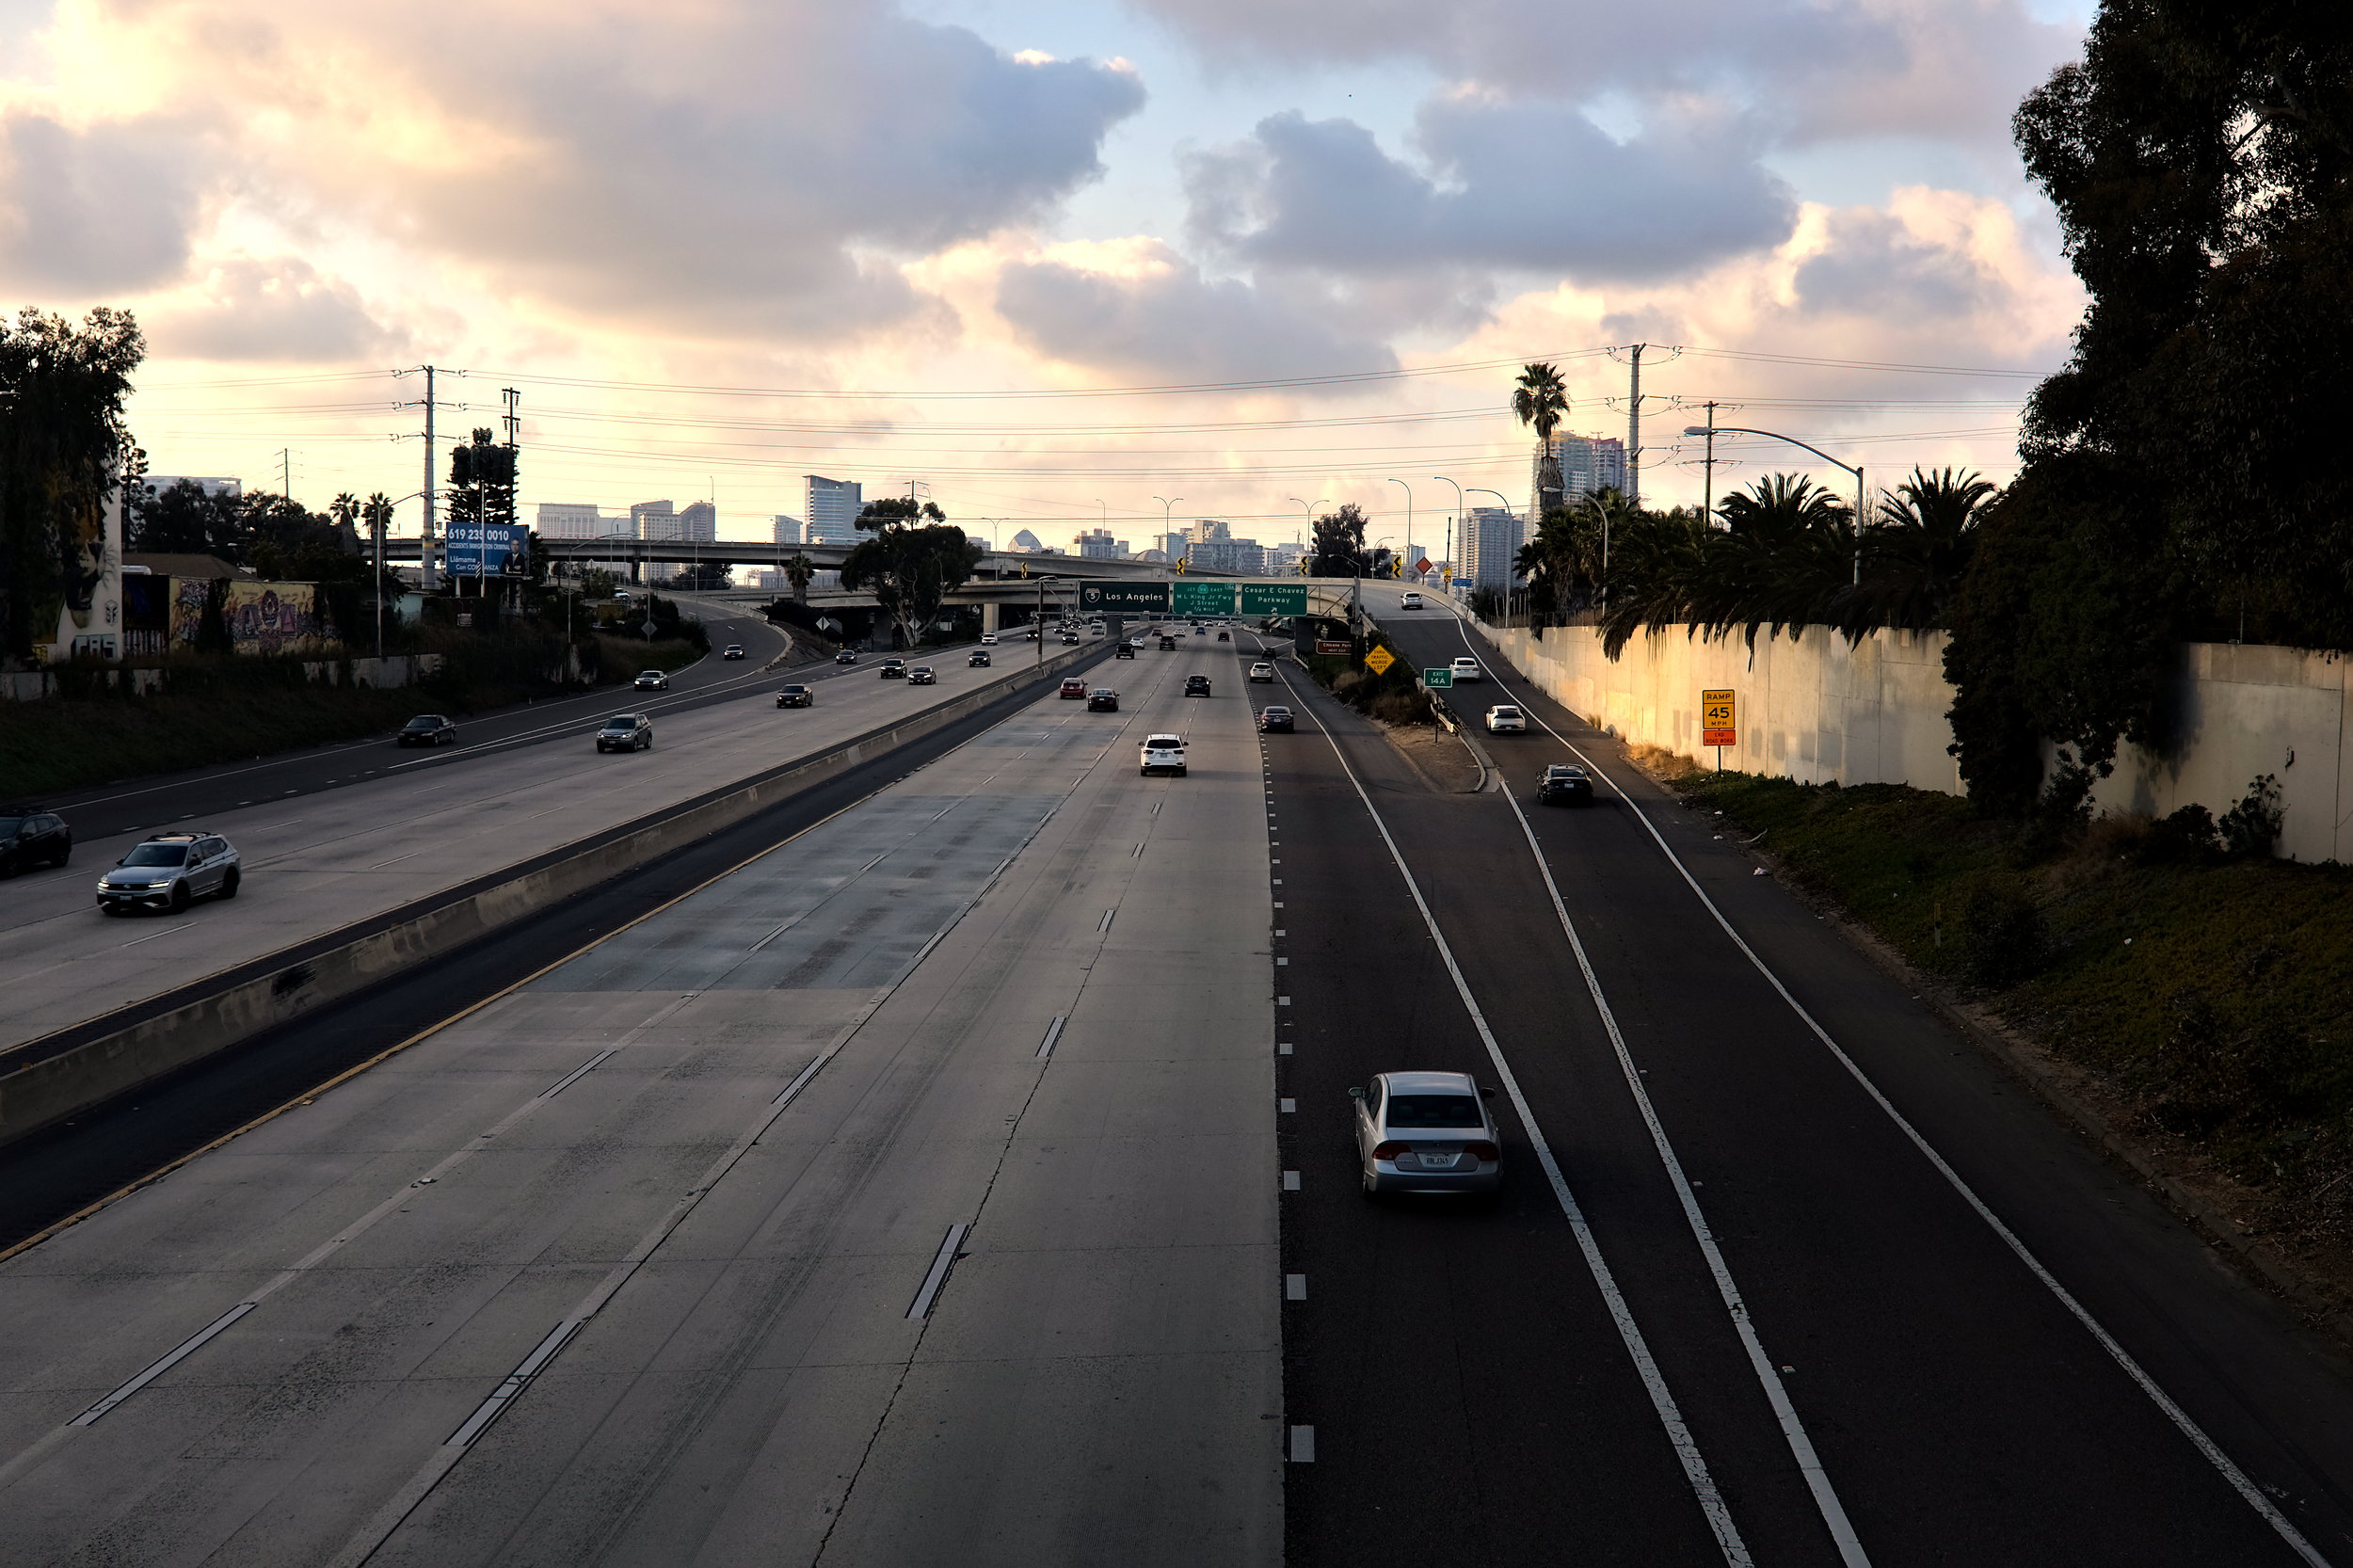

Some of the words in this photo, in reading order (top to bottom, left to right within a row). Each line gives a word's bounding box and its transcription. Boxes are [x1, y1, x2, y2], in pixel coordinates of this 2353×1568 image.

[448, 529, 466, 539] 619
[487, 530, 509, 541] 0010
[1126, 593, 1163, 602] Angeles
[1257, 596, 1290, 604] Parkway
[1708, 707, 1730, 719] 45
